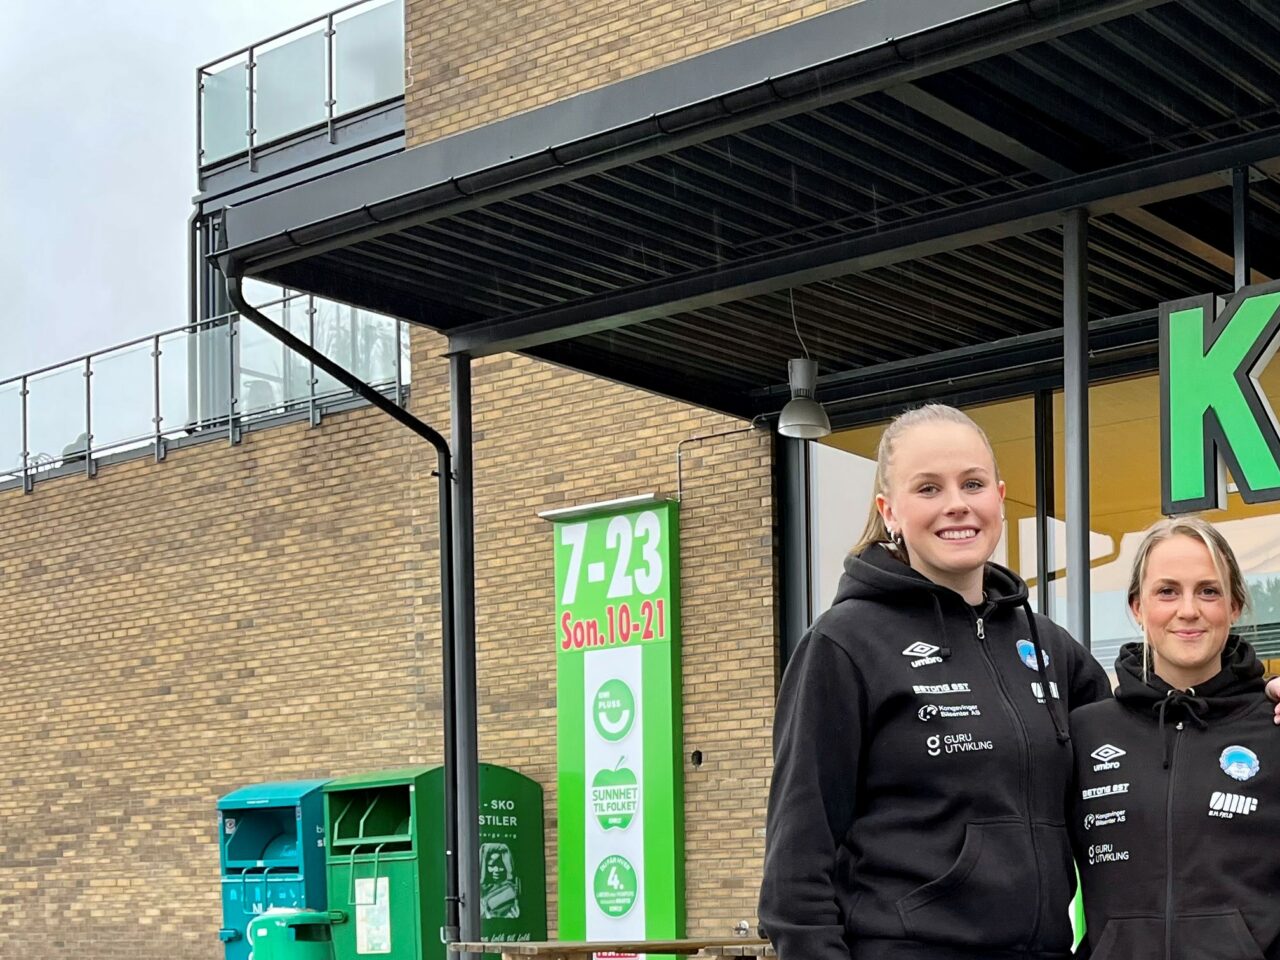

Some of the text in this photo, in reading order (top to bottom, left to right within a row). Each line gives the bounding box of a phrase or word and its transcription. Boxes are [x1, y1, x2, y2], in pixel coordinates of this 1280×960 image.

[561, 510, 663, 606] 7-23
[911, 656, 943, 668] umbro
[944, 733, 972, 744] GURU
[945, 741, 993, 754] UTVIKLING
[1093, 761, 1121, 772] umbro
[592, 787, 638, 802] SUNNHET
[491, 800, 515, 810] SKO
[594, 801, 637, 813] TIL FOLKET
